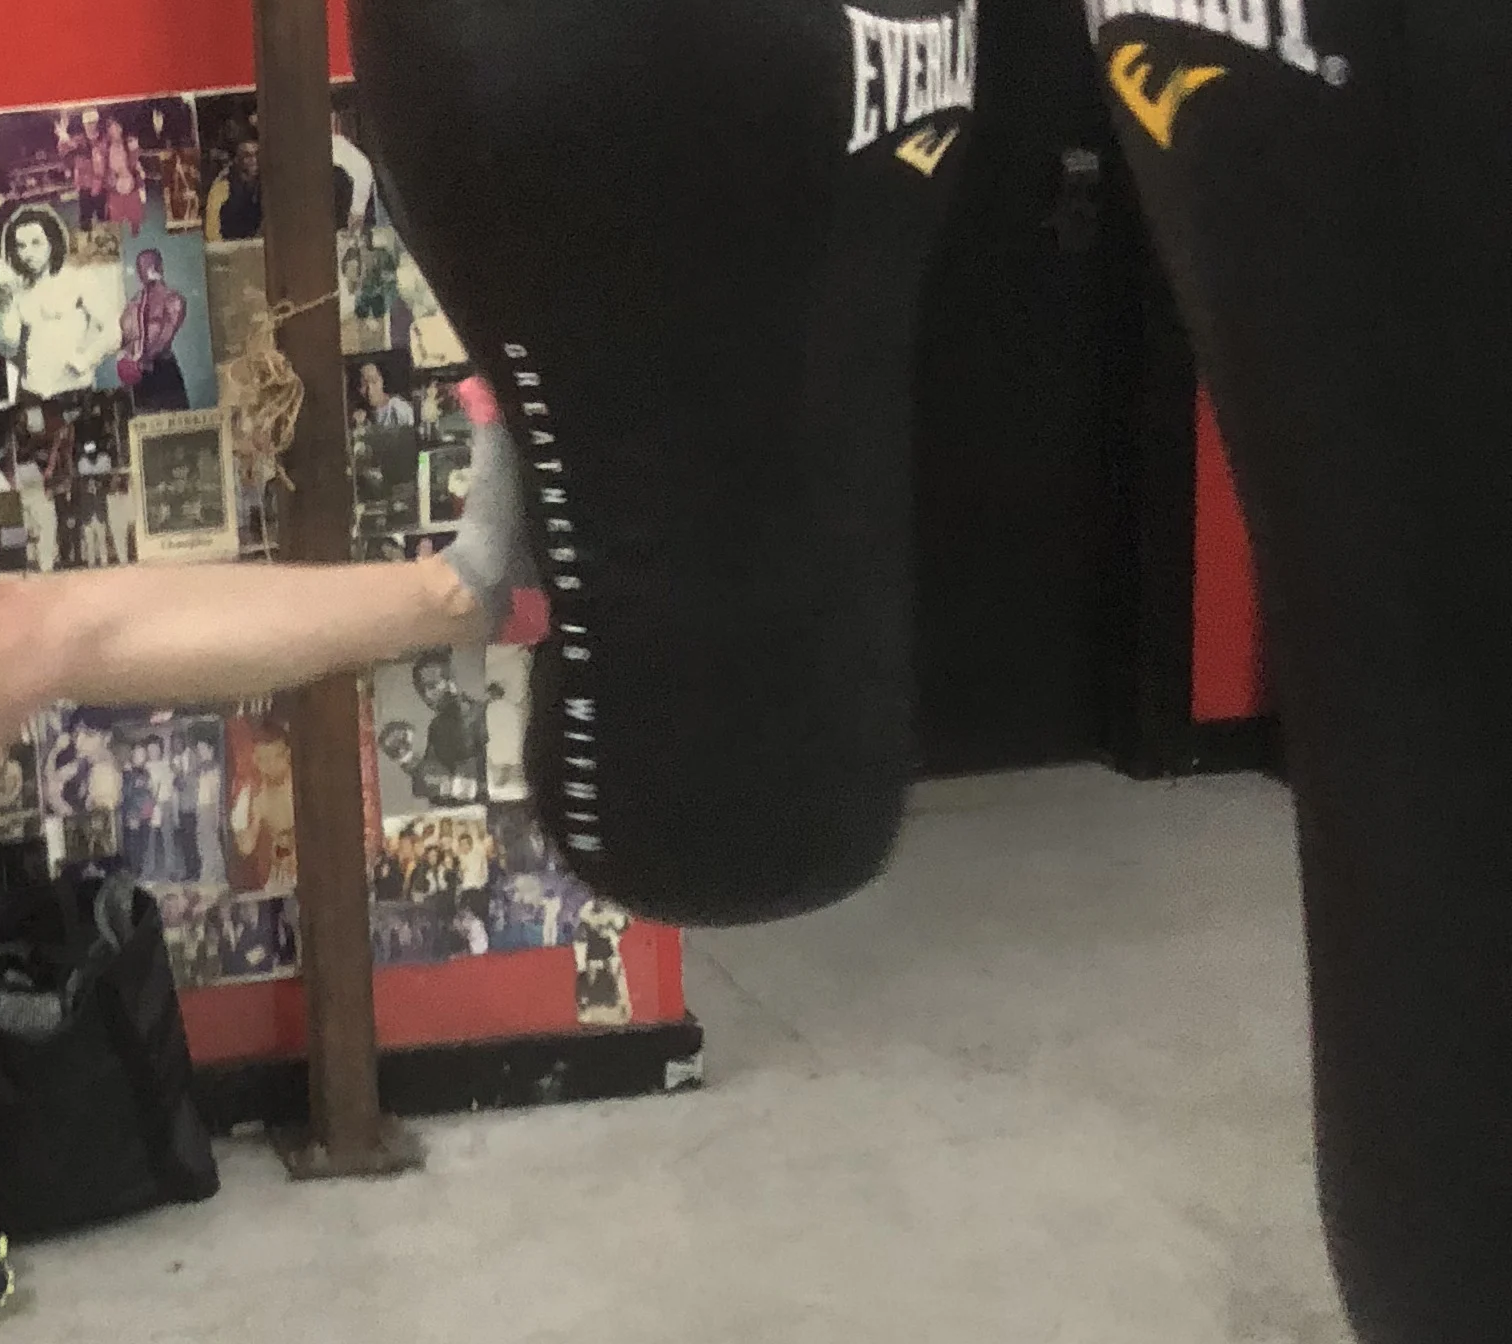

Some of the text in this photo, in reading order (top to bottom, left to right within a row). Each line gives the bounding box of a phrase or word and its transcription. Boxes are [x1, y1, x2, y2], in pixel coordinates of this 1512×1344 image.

[504, 342, 605, 851] GREATNESS IS WITHIN
